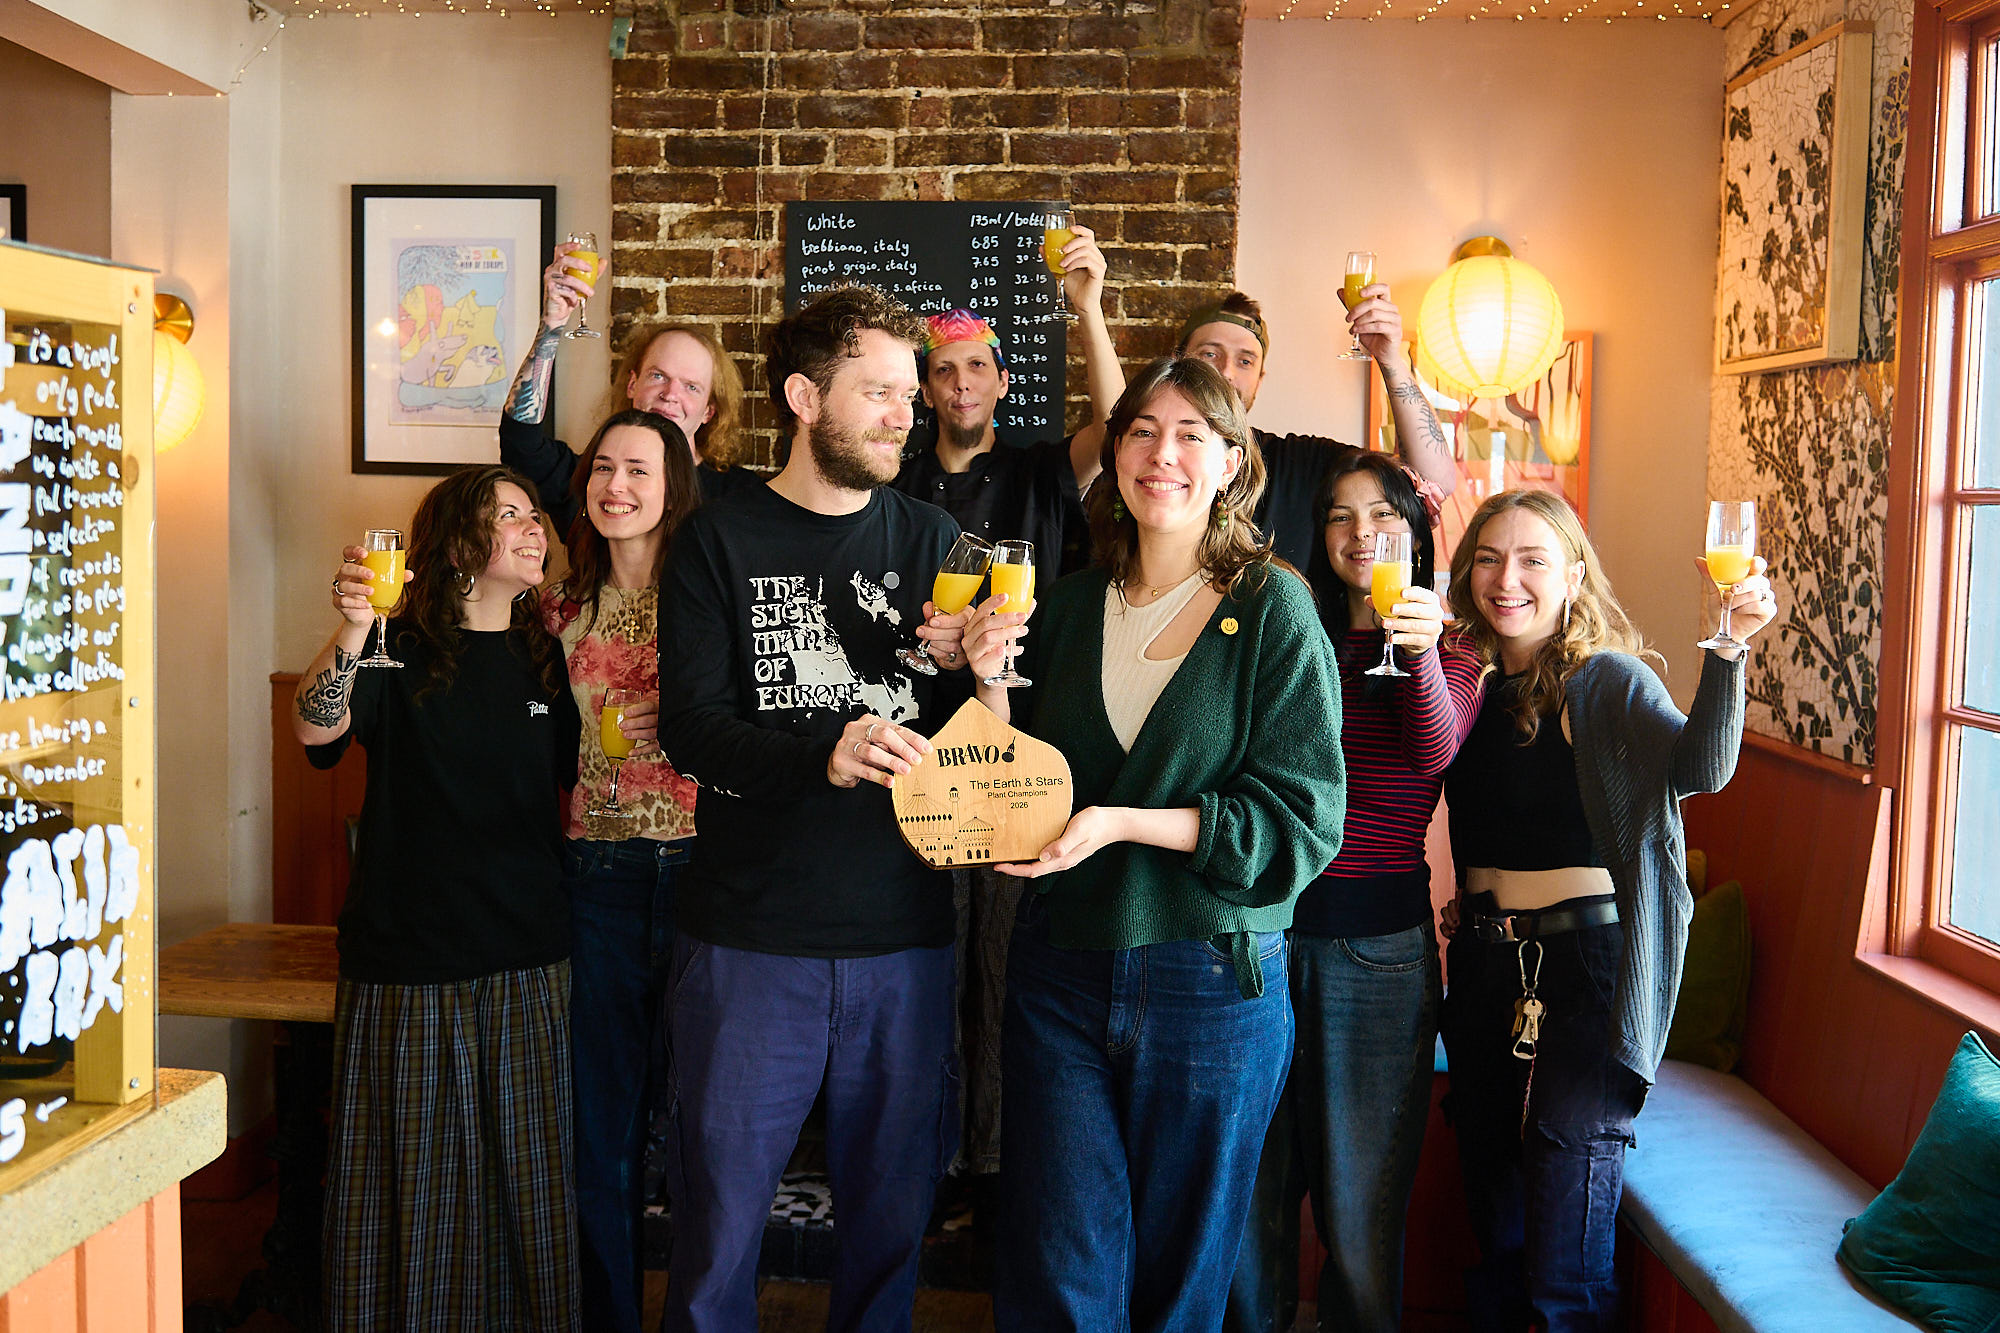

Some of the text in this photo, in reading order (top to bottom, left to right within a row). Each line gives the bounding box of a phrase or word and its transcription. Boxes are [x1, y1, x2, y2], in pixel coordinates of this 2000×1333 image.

[808, 213, 856, 231] White
[874, 238, 910, 257] italy
[971, 236, 999, 250] 6.85
[1017, 236, 1045, 248] 27.3
[802, 260, 835, 278] pinot
[886, 259, 917, 276] italy
[971, 256, 1000, 268] 7.65
[970, 276, 997, 290] 8.15
[1014, 274, 1048, 284] 32.15
[920, 297, 952, 311] chile
[970, 296, 998, 308] 8.25
[1014, 293, 1049, 305] 32.65
[1012, 333, 1046, 344] 31.65
[29, 327, 52, 364] is
[57, 345, 74, 368] a
[74, 334, 120, 378] vinyl
[1010, 353, 1048, 364] 34.70
[1008, 373, 1048, 384] 35.70
[37, 375, 120, 417] only pub.
[1008, 393, 1048, 405] 38.20
[1008, 415, 1047, 426] 39.30
[34, 417, 122, 451] each month
[33, 450, 120, 480] we invite a
[36, 482, 124, 517] pal to curate
[34, 514, 114, 557] a selection
[32, 552, 122, 593] of records
[749, 576, 807, 602] THE
[22, 580, 126, 626] for us to play
[751, 602, 826, 628] SICK
[8, 622, 120, 666] alongside our
[753, 629, 824, 655] MAN
[6, 651, 126, 703] house collection
[754, 658, 788, 682] OF
[756, 683, 864, 710] EUROPE
[28, 716, 91, 750] having
[94, 720, 107, 735] a
[936, 744, 1000, 768] BRAVO
[23, 756, 106, 785] november
[970, 776, 1064, 790] The Earth & Stars
[1008, 790, 1048, 798] Champions
[0, 824, 140, 973] ACID
